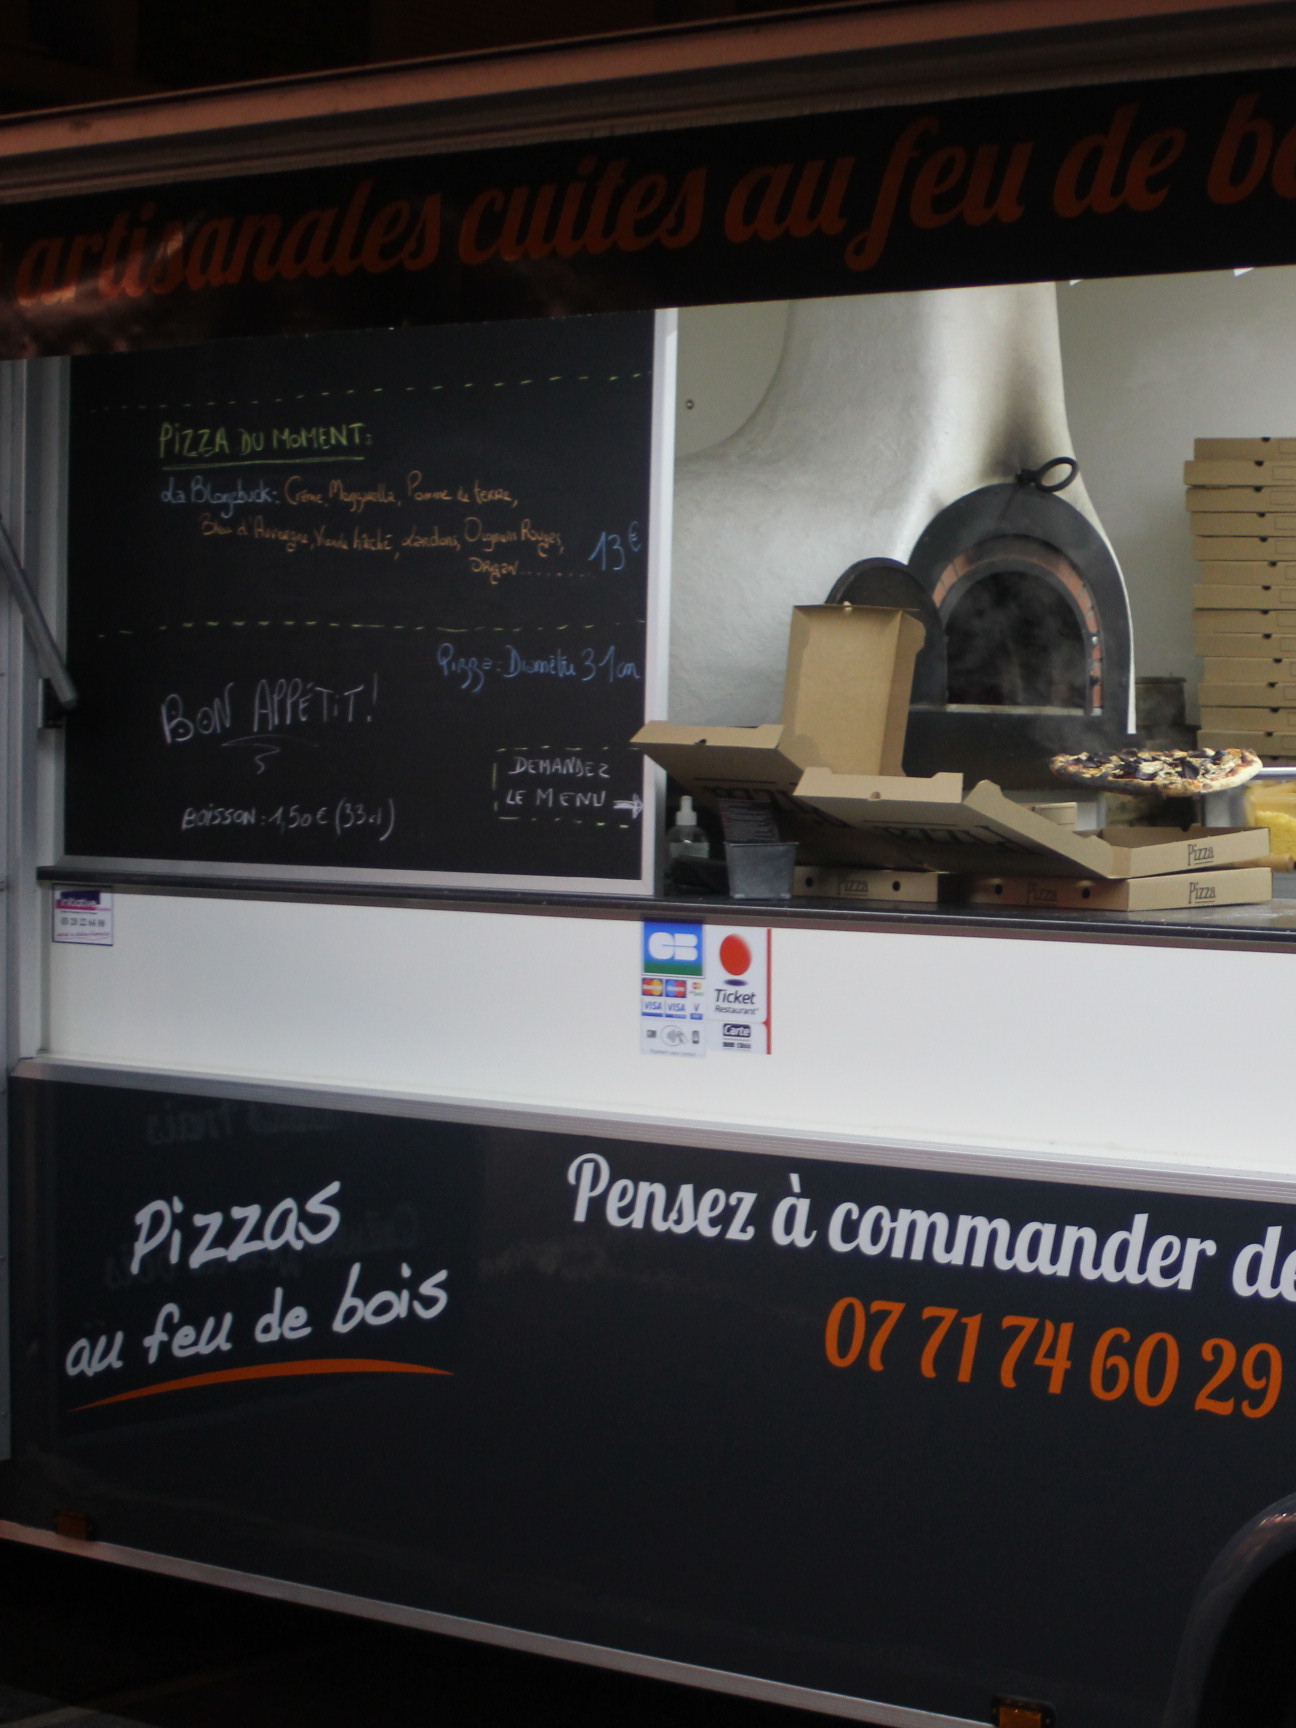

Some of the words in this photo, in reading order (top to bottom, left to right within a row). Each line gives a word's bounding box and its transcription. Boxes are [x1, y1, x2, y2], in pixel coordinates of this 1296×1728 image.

[16, 177, 443, 307] artisanales
[458, 155, 708, 265] cuites
[724, 155, 856, 243] au
[845, 113, 1035, 271] feu
[1052, 101, 1187, 218] de
[241, 428, 264, 455] DU
[160, 682, 234, 744] BON
[506, 788, 527, 805] LE
[535, 788, 607, 808] MENU
[1187, 842, 1214, 866] Pizza
[836, 873, 869, 896] Pizza
[1026, 880, 1058, 904] Pizza
[1188, 881, 1216, 904] Pizza
[648, 932, 698, 961] CB
[644, 1001, 662, 1010] VISA
[668, 1002, 685, 1012] VISA
[714, 989, 757, 1004] Ticket
[724, 1025, 751, 1036] Carte
[129, 1180, 342, 1275] Pizzas
[566, 1152, 758, 1243] Pensez
[771, 1173, 817, 1249] à
[827, 1199, 1217, 1293] commander
[66, 1329, 124, 1378] au
[144, 1303, 233, 1365] feu
[254, 1287, 312, 1344] de
[333, 1262, 449, 1334] bois
[824, 1294, 904, 1373] 07
[918, 1307, 984, 1384] 71
[999, 1314, 1074, 1397] 74
[1088, 1325, 1181, 1408] 60
[1193, 1336, 1284, 1420] 29
